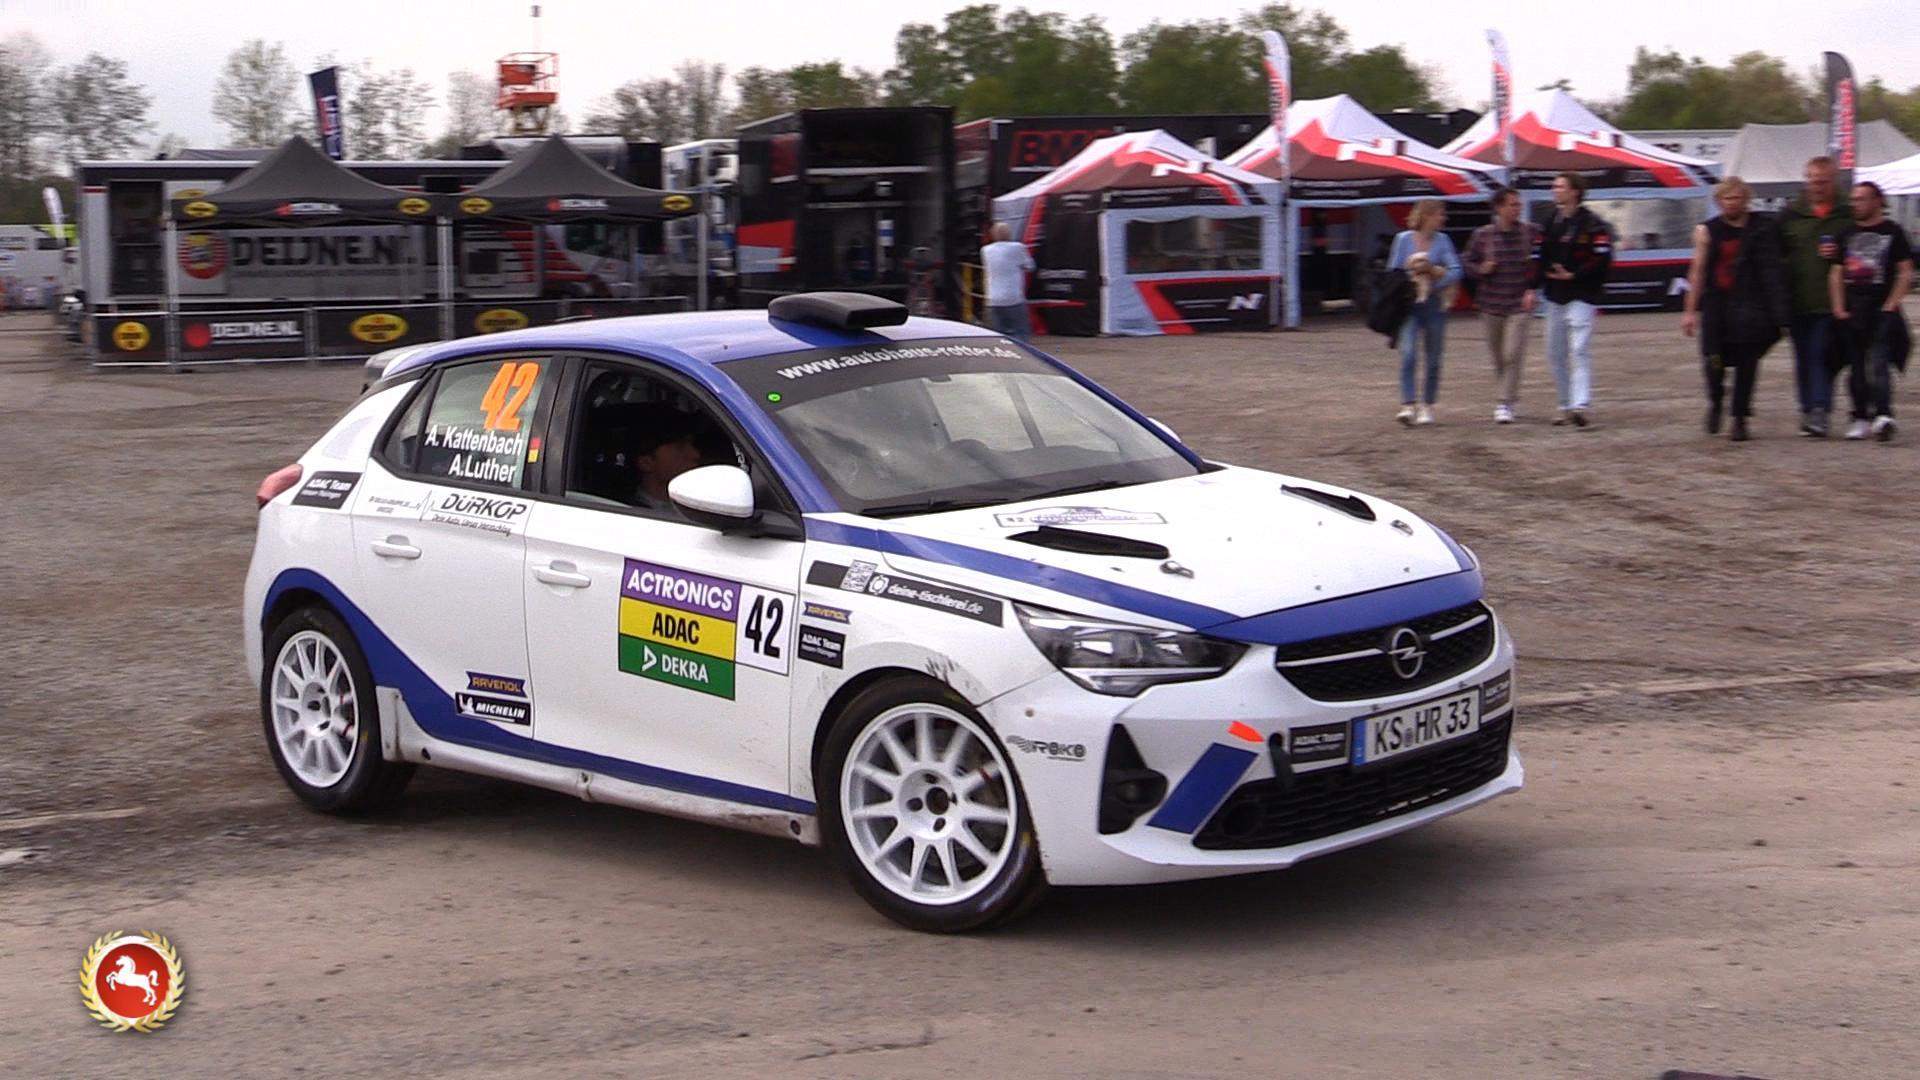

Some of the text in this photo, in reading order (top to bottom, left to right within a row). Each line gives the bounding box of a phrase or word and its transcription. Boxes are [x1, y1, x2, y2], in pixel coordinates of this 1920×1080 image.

[776, 345, 1022, 380] www.autohaus-rotter.de
[480, 361, 540, 432] 42
[424, 425, 524, 456] A. Kattenbach
[441, 493, 528, 520] DÜRKOP
[626, 569, 734, 612] ACTRONICS
[652, 612, 700, 645] ADAC
[744, 594, 784, 659] 42
[472, 676, 521, 692] RAVENOL
[661, 654, 709, 683] DEKRA
[475, 702, 526, 719] MICHELIN
[1374, 716, 1403, 755] KS
[1415, 706, 1442, 744] HR
[1447, 697, 1472, 734] 33
